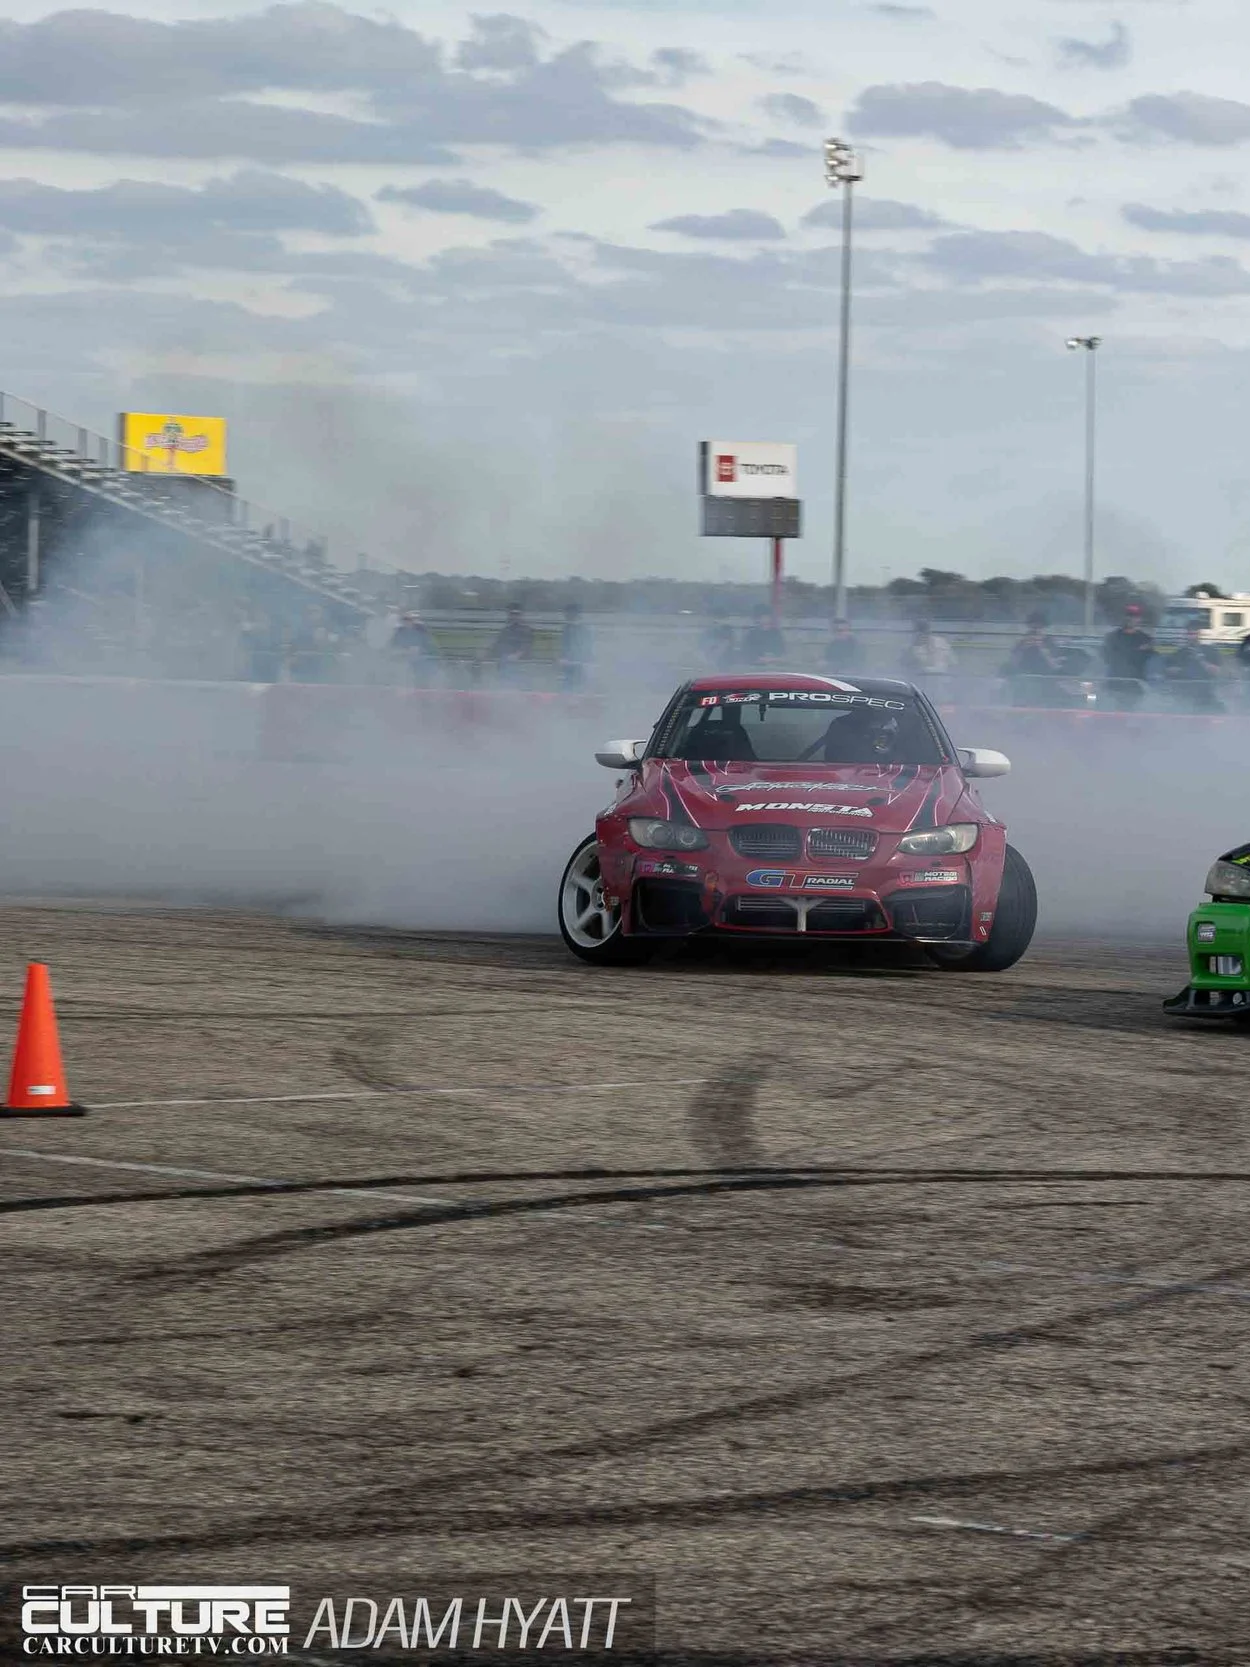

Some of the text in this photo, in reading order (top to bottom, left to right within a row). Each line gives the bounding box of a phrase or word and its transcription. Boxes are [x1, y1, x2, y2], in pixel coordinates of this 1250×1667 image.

[701, 696, 718, 706] FD
[769, 692, 905, 711] PROSPEC
[735, 802, 873, 817] MONSTA
[807, 876, 855, 886] RADIAL
